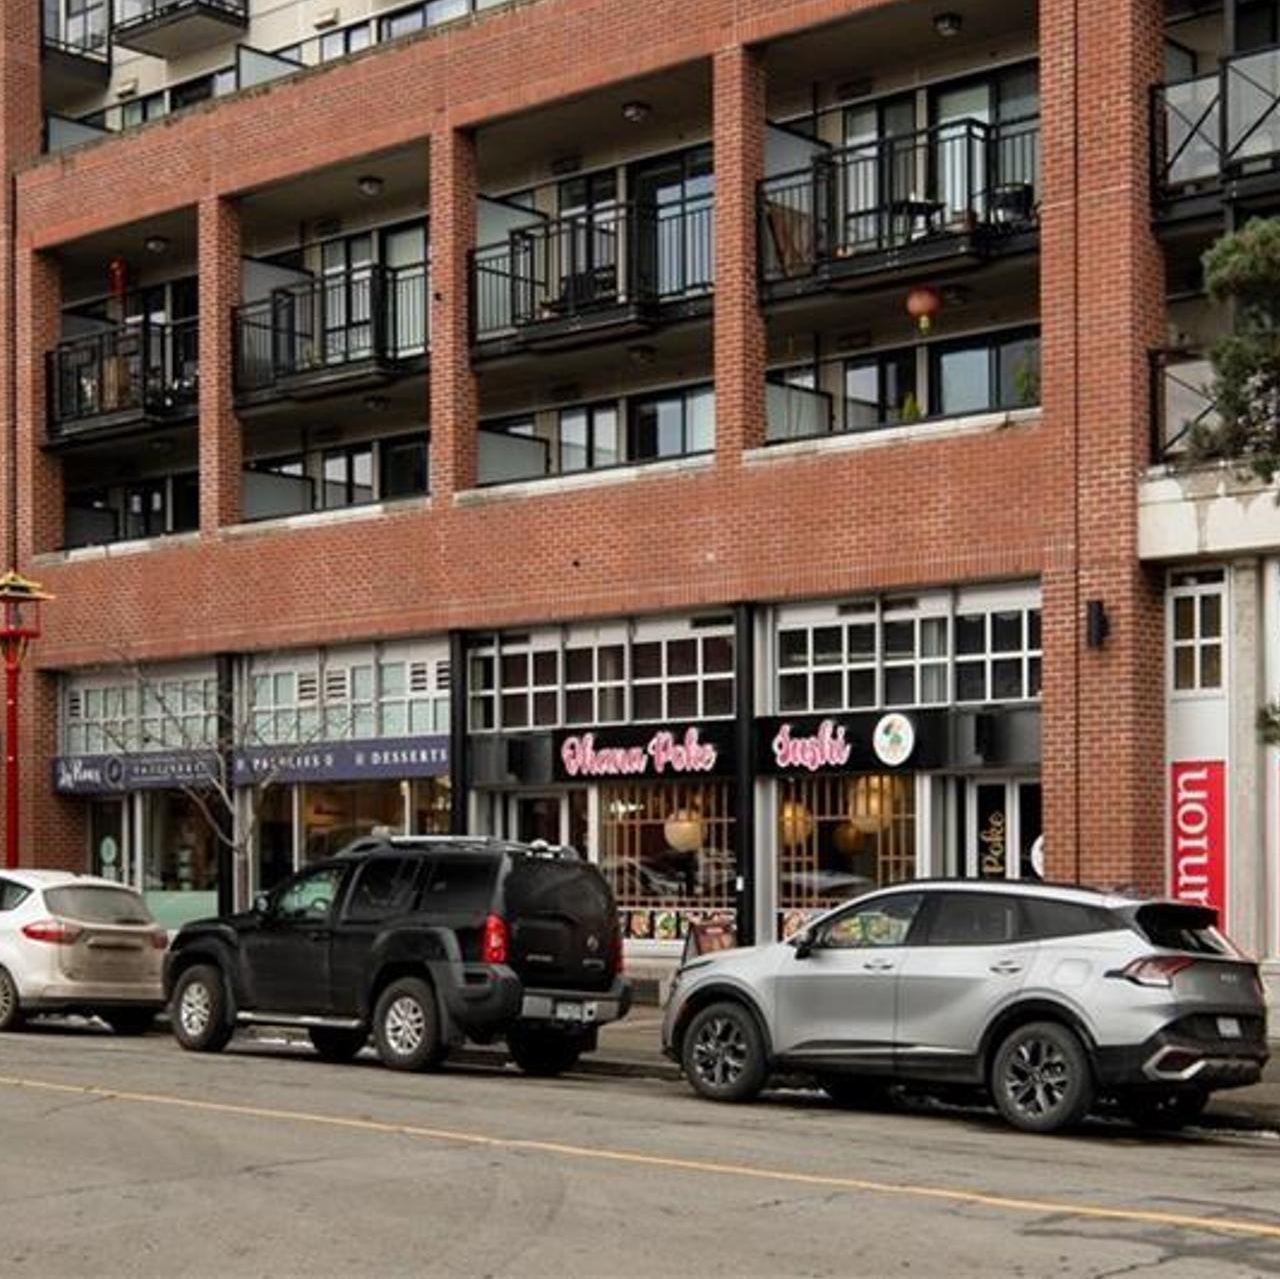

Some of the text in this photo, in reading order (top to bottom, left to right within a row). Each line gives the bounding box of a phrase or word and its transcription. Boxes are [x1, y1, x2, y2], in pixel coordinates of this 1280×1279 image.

[372, 748, 448, 766] DESSERTS
[561, 726, 717, 776] Ohana Poke
[772, 719, 852, 771] Sushi
[981, 811, 1005, 873] Poke
